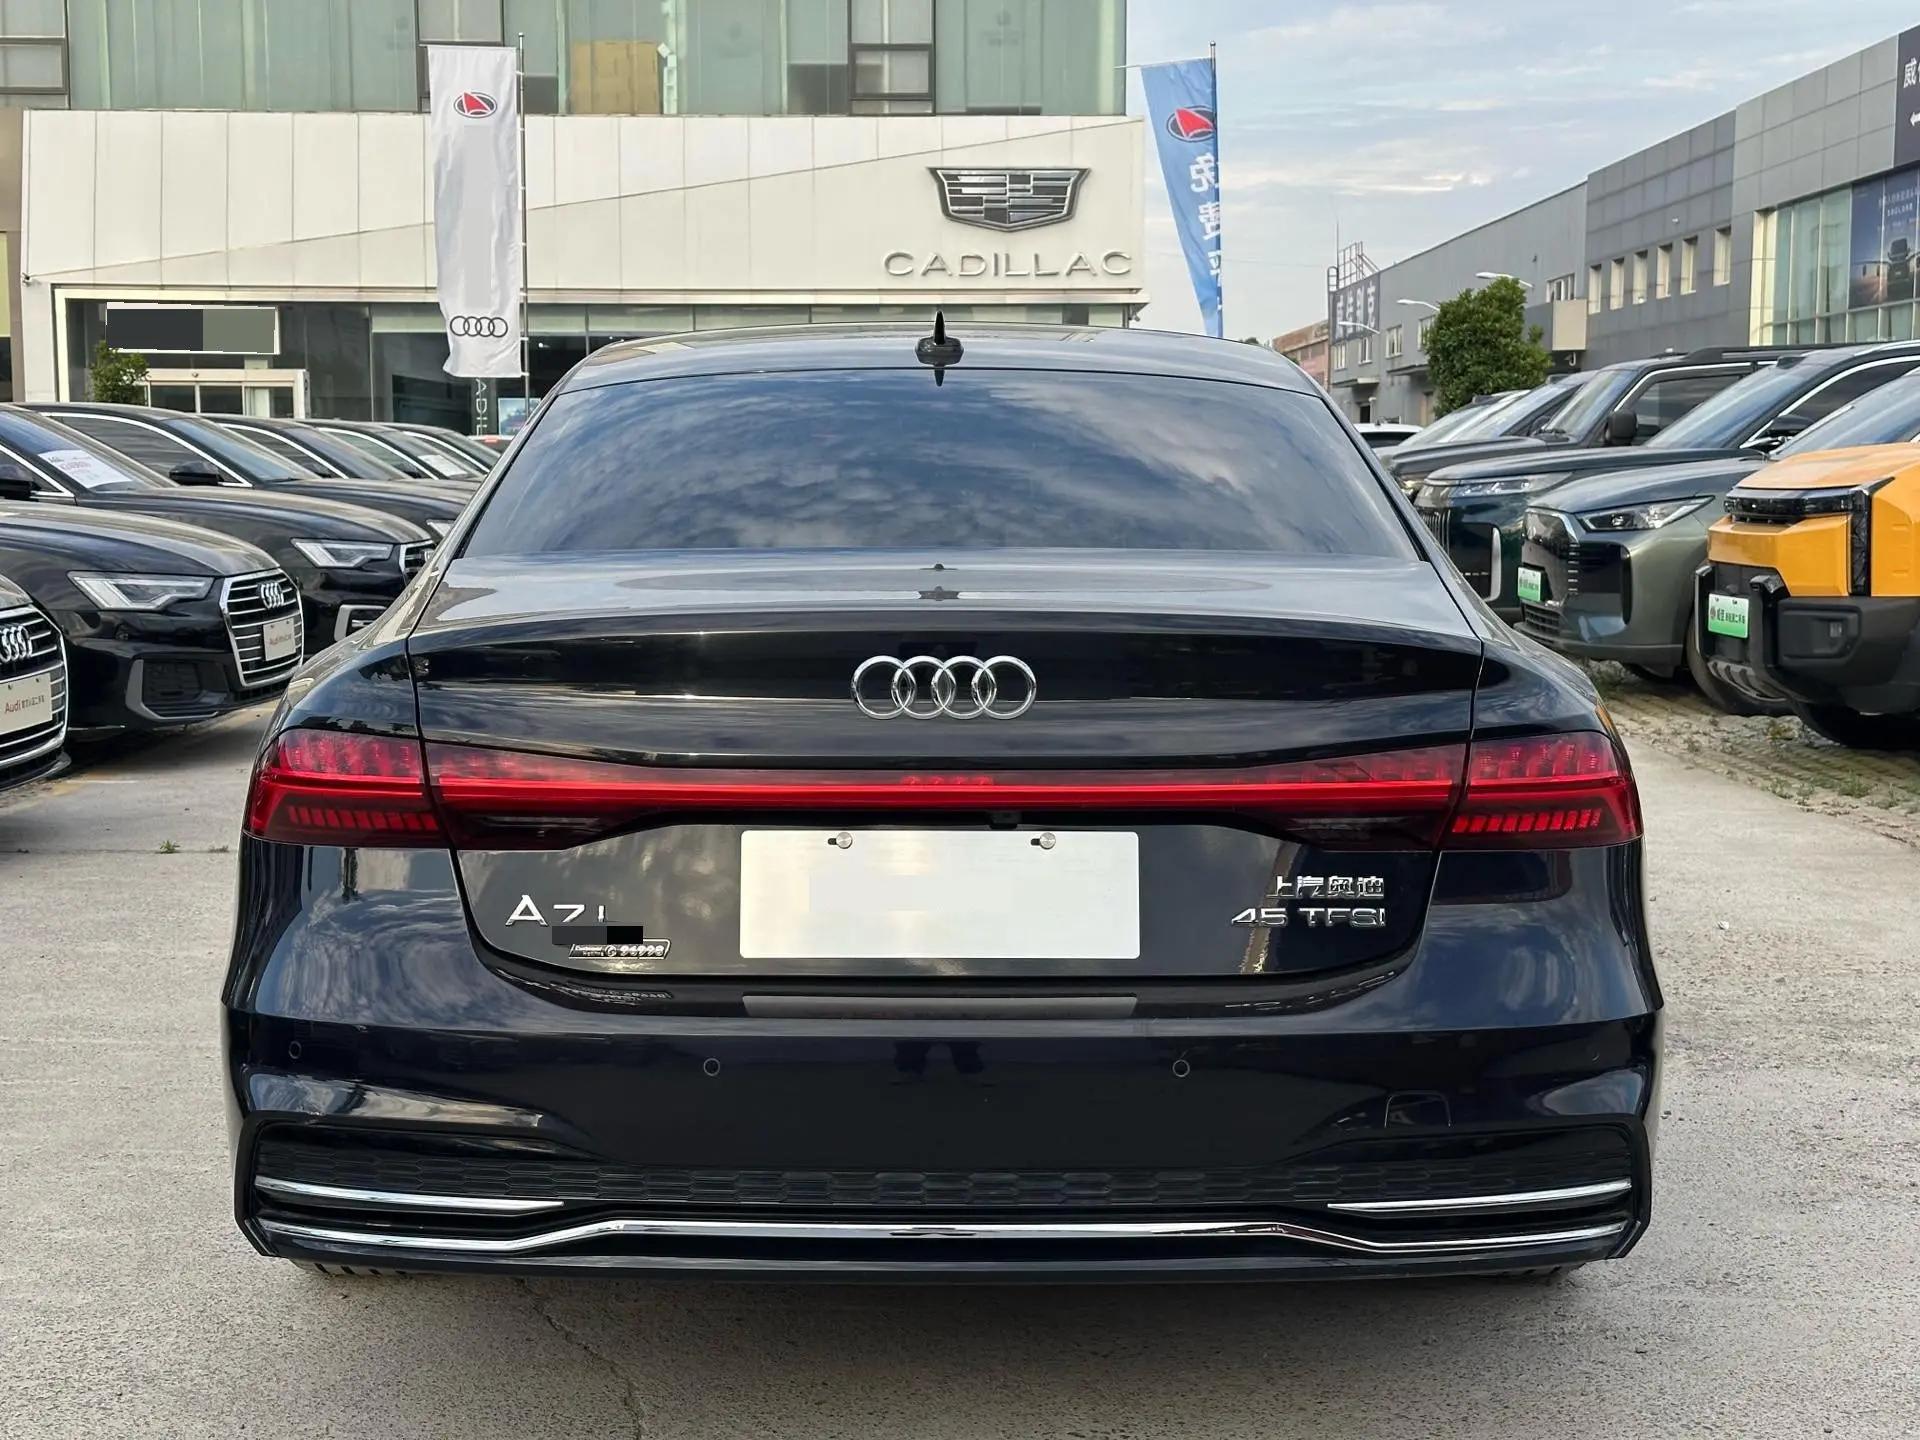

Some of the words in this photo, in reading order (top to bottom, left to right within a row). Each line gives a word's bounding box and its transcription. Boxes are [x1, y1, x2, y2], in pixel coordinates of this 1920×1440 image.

[884, 250, 1133, 277] CADILLAC
[1266, 875, 1384, 898] 上汽奥迪
[1231, 907, 1288, 926] 45
[1298, 907, 1386, 926] TFSI
